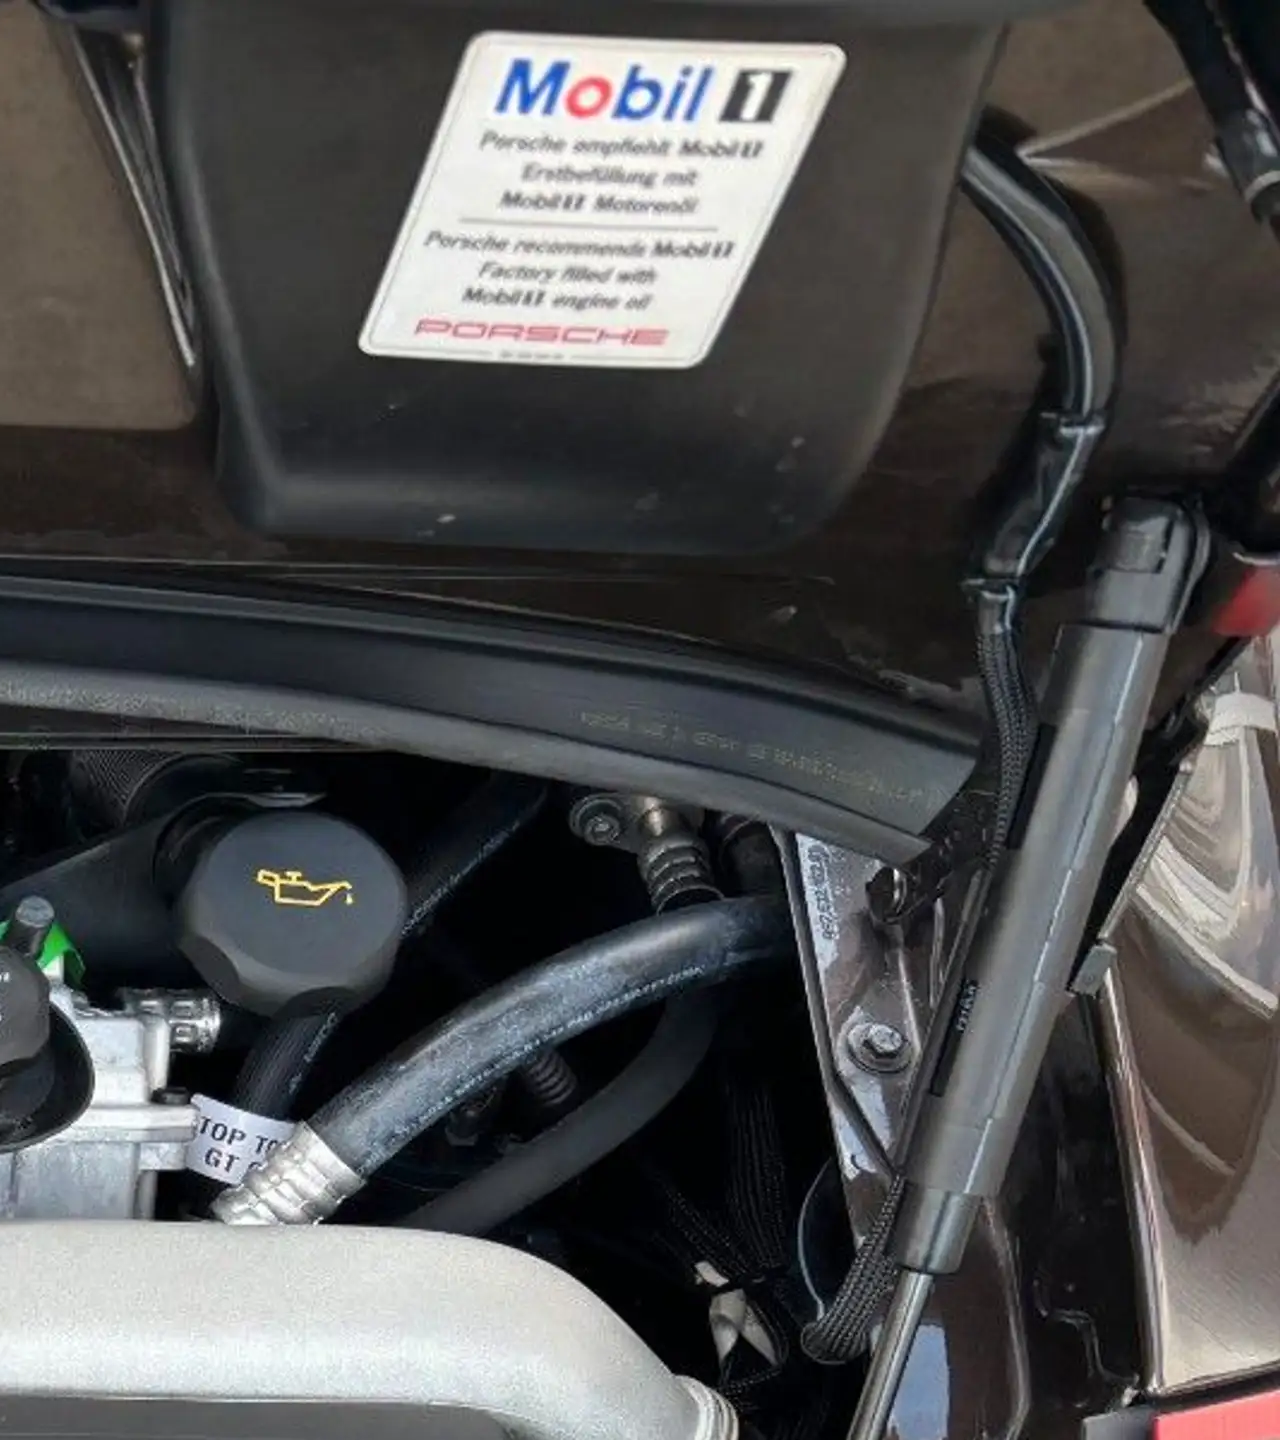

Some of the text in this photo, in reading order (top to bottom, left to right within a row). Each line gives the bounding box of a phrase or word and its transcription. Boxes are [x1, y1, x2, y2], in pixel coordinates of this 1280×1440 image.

[494, 58, 714, 121] Mobil
[480, 128, 566, 153] Porsche
[521, 161, 699, 188] Erstbefüllung mit
[593, 193, 699, 214] Motorenöl
[423, 229, 507, 252] Porsche
[513, 239, 646, 258] recommends
[478, 261, 658, 285] Factory filled with
[551, 294, 619, 313] engine
[624, 293, 654, 310] oil
[415, 318, 670, 346] PORSCHE
[200, 1116, 247, 1145] TOP
[204, 1147, 240, 1173] GT
